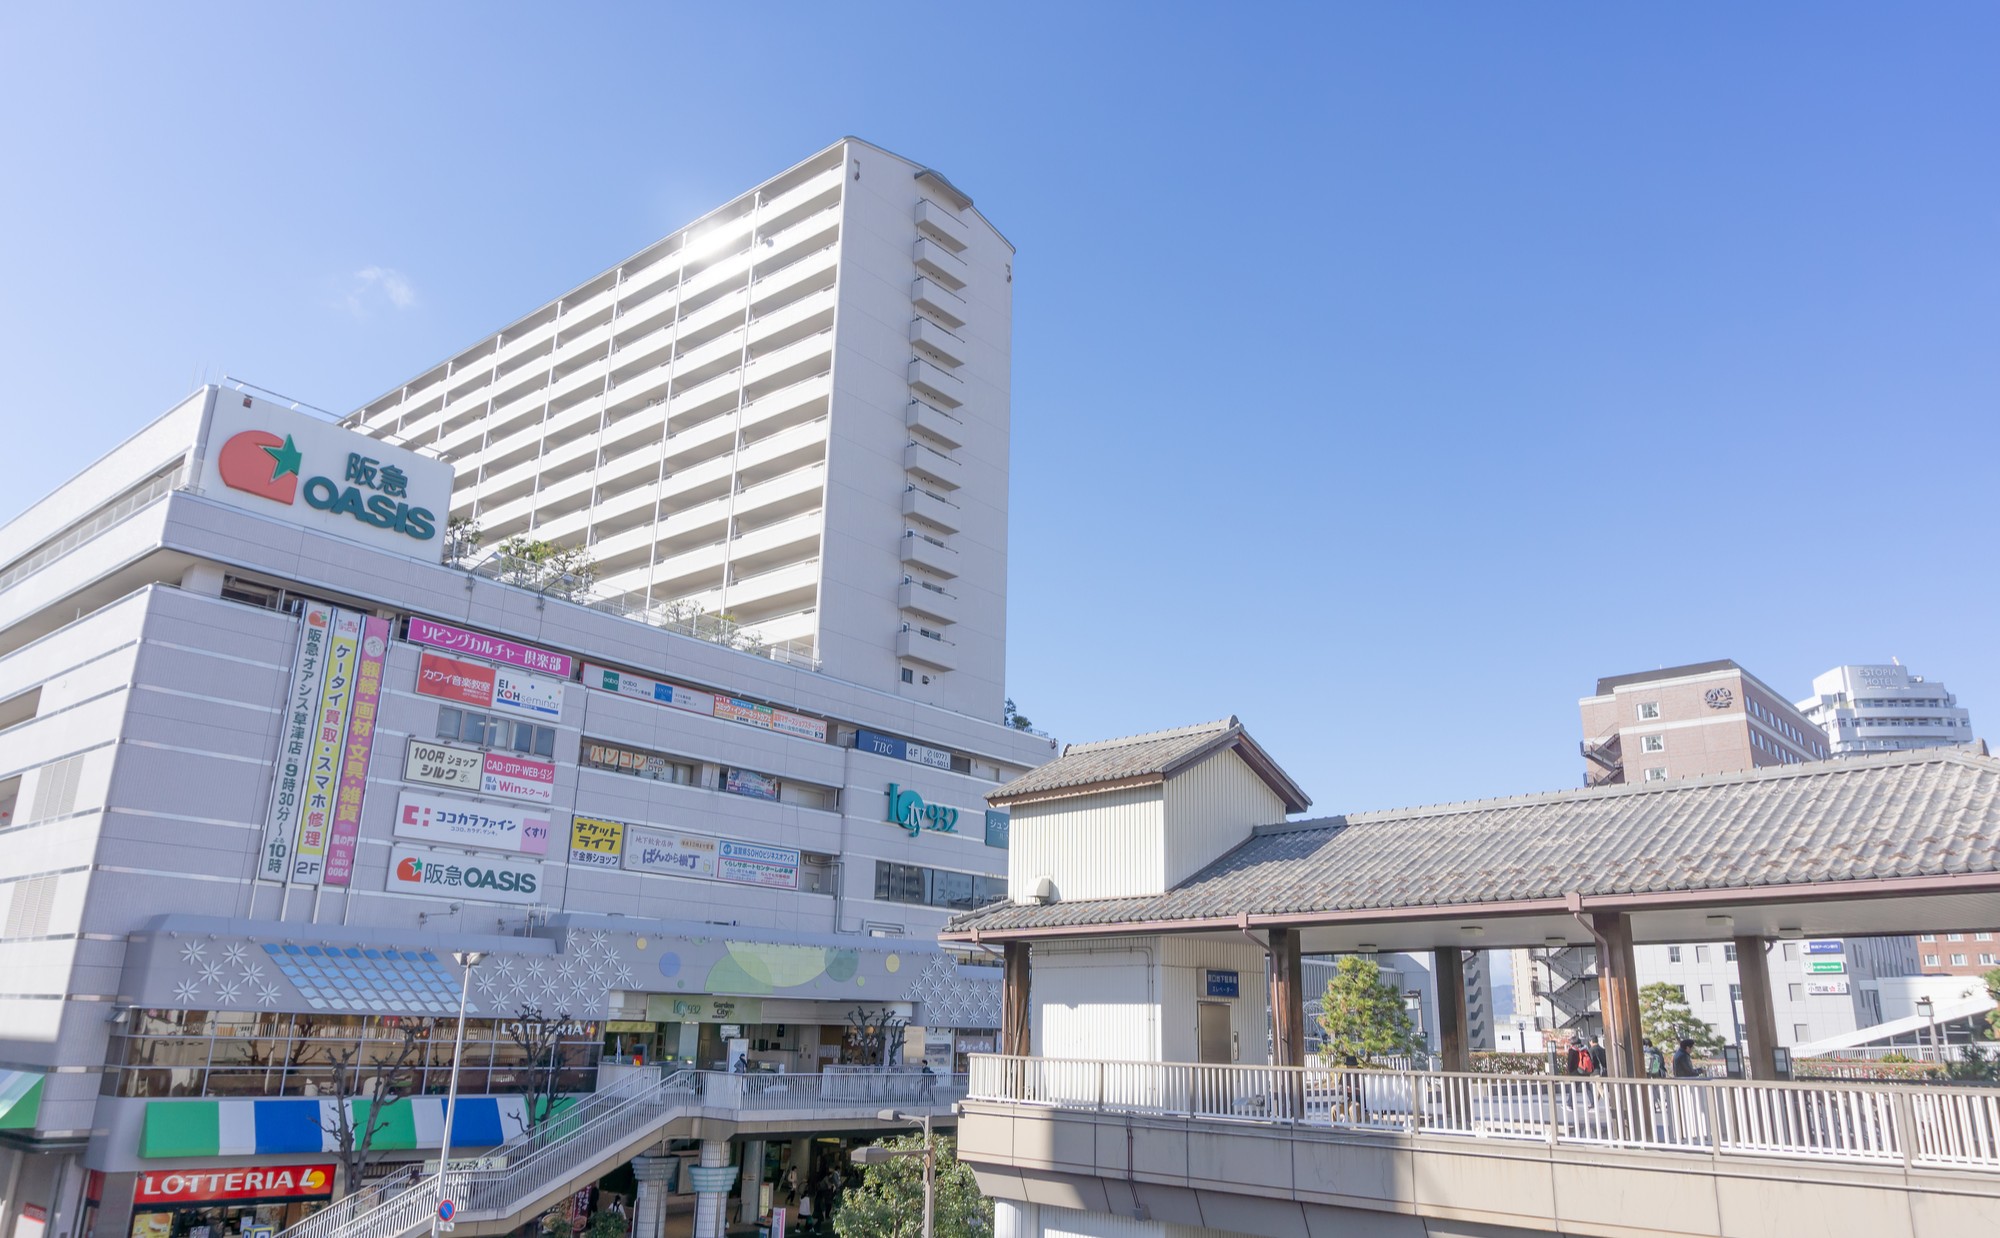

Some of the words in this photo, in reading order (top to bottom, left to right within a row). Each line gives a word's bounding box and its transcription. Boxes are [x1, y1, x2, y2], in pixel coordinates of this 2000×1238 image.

[345, 452, 408, 498] 阪急
[303, 475, 436, 540] OASIS
[422, 624, 562, 672] リビングカルチャー倶楽部
[1858, 668, 1898, 676] ESTOPIA
[423, 669, 490, 693] カワイ音楽教室
[498, 679, 509, 689] EI
[288, 628, 322, 755] 阪急オアシス草津店
[497, 688, 520, 701] KOH
[521, 696, 560, 709] seminar
[304, 645, 351, 847] ケータイ買取・スマホ修理
[338, 660, 380, 823] 額縁・画材・文具・雑貨
[873, 740, 893, 755] TBC
[414, 747, 446, 764] 100円
[447, 755, 478, 768] ショップ
[590, 745, 647, 771] パソコン
[648, 757, 664, 766] CAD
[909, 748, 918, 757] 4F
[933, 751, 948, 760] (077)
[420, 764, 457, 781] シルク
[647, 764, 662, 773] DTP
[485, 775, 497, 784] 個人
[499, 779, 550, 798] Winスクール
[436, 811, 516, 831] ココカラファイン
[524, 826, 547, 839] くすり
[576, 822, 620, 838] チケット
[578, 836, 616, 851] ライフ
[267, 843, 286, 874] 10時
[336, 849, 346, 858] TEL
[579, 850, 619, 865] 金券ショップ
[642, 848, 700, 870] ばんから横丁
[296, 861, 320, 875] 2F
[328, 867, 348, 877] 0064
[424, 863, 536, 893] 阪急OASIS
[717, 1009, 729, 1018] City
[501, 1022, 584, 1036] LOTTERIA
[144, 1171, 293, 1195] LOTTERIA
